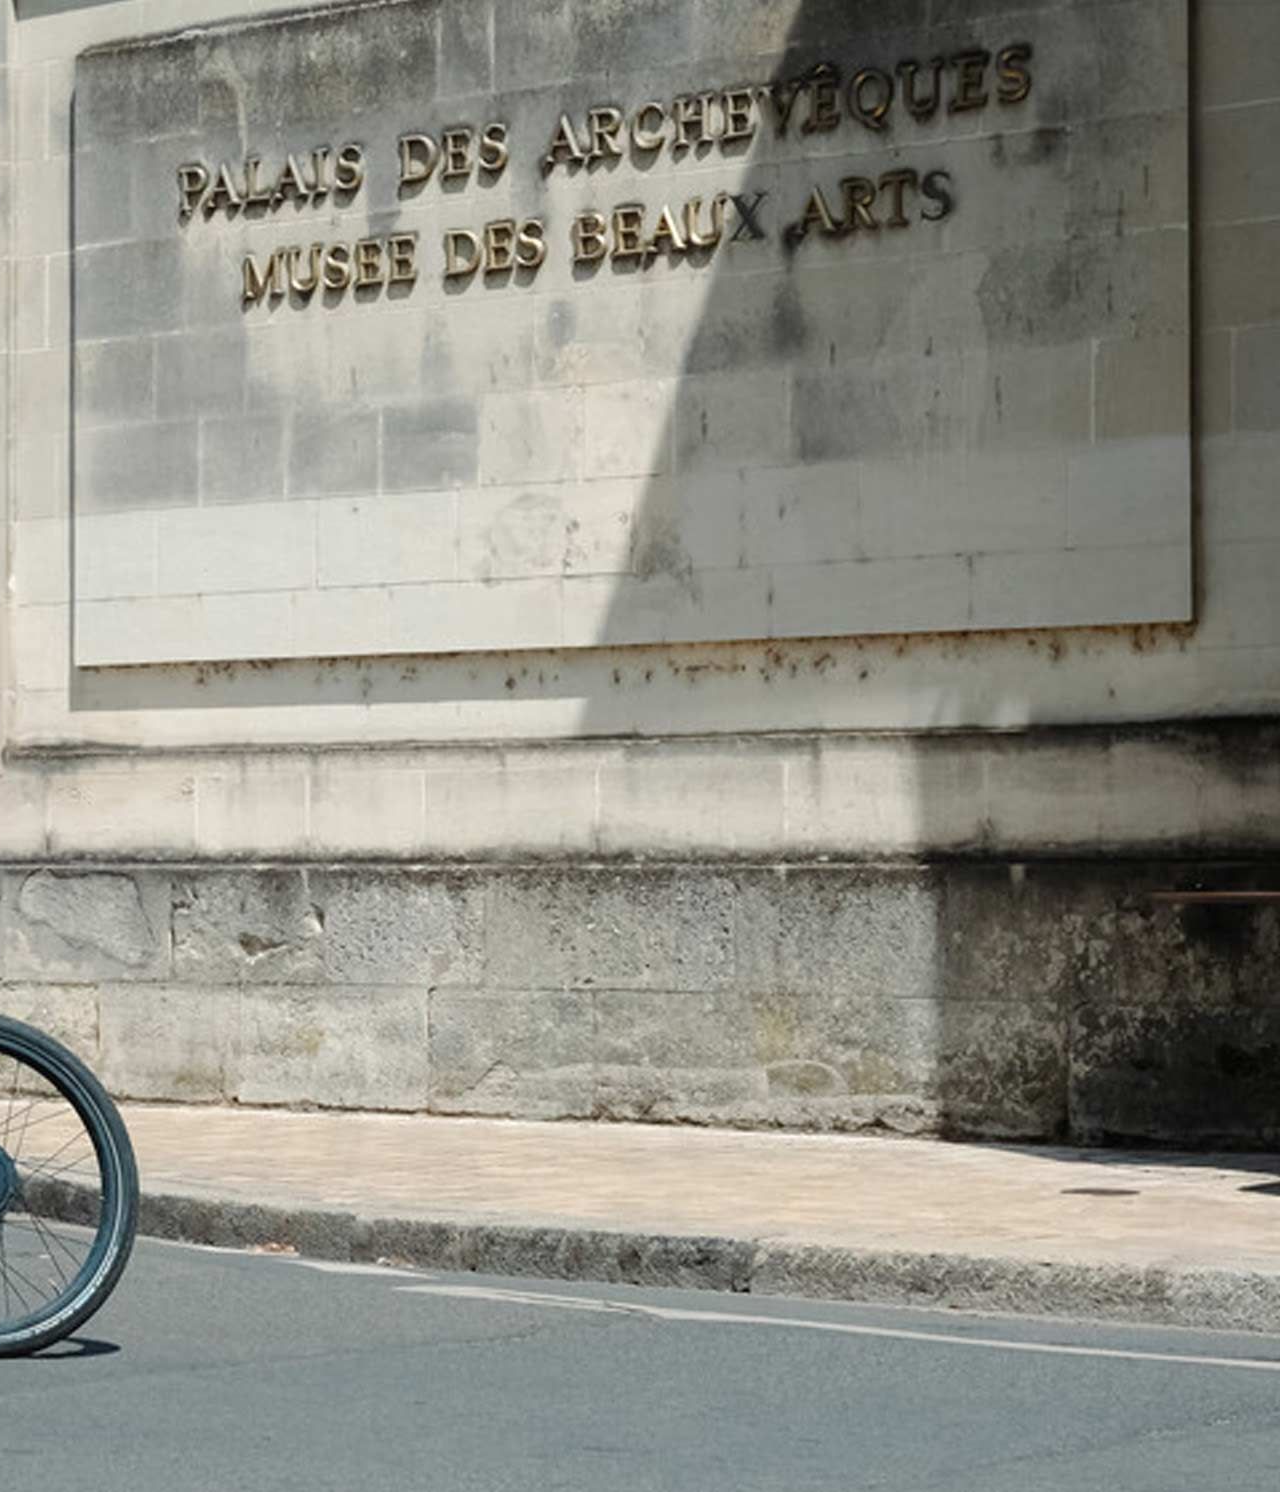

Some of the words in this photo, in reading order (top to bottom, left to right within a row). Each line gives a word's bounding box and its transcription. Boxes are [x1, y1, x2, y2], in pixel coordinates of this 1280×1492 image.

[177, 145, 363, 213] PALAIS
[400, 122, 508, 185] DES
[546, 43, 1033, 162] ARCHEVÊQUES
[243, 230, 418, 301] MUSEE
[445, 219, 545, 277] DES
[573, 192, 766, 259] BEAUX
[795, 169, 954, 236] ARTS
